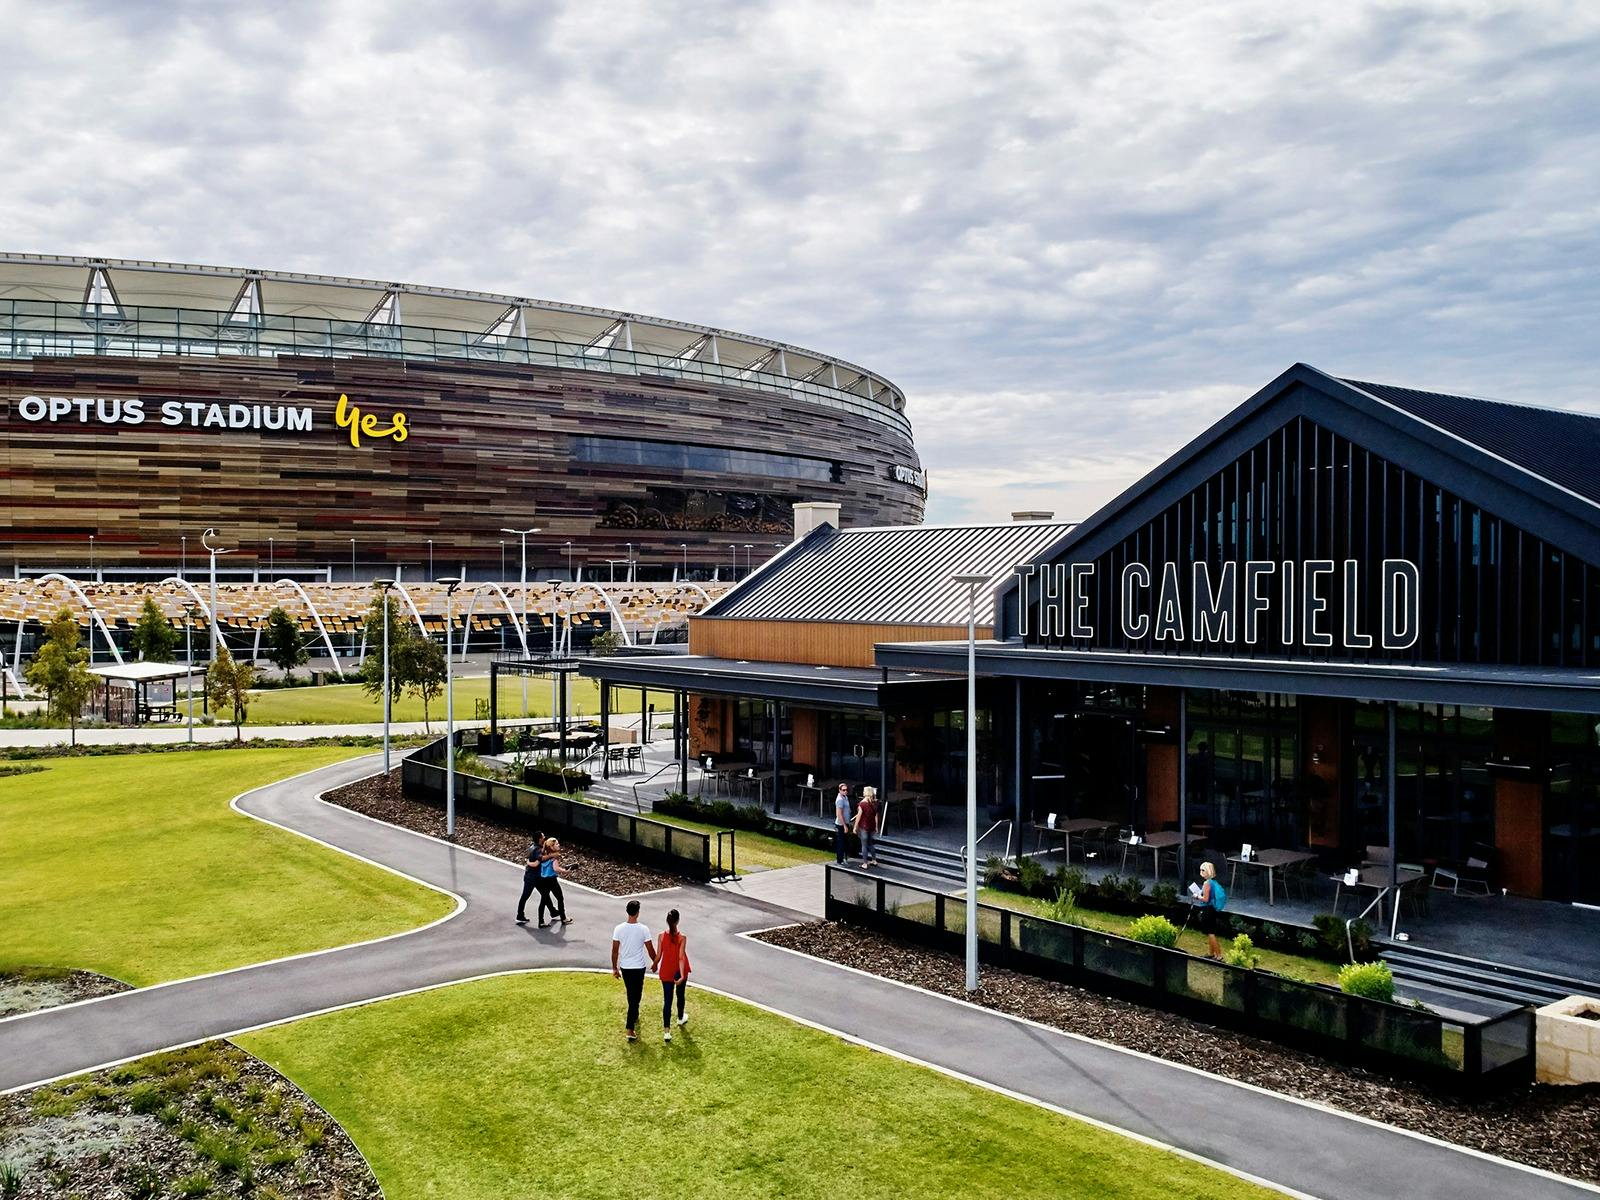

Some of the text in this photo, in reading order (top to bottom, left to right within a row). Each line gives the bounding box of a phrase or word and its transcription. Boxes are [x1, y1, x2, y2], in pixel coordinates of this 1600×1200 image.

[18, 396, 313, 432] OPTUS STADIUM
[1013, 559, 1419, 649] THE CAMFIELD
